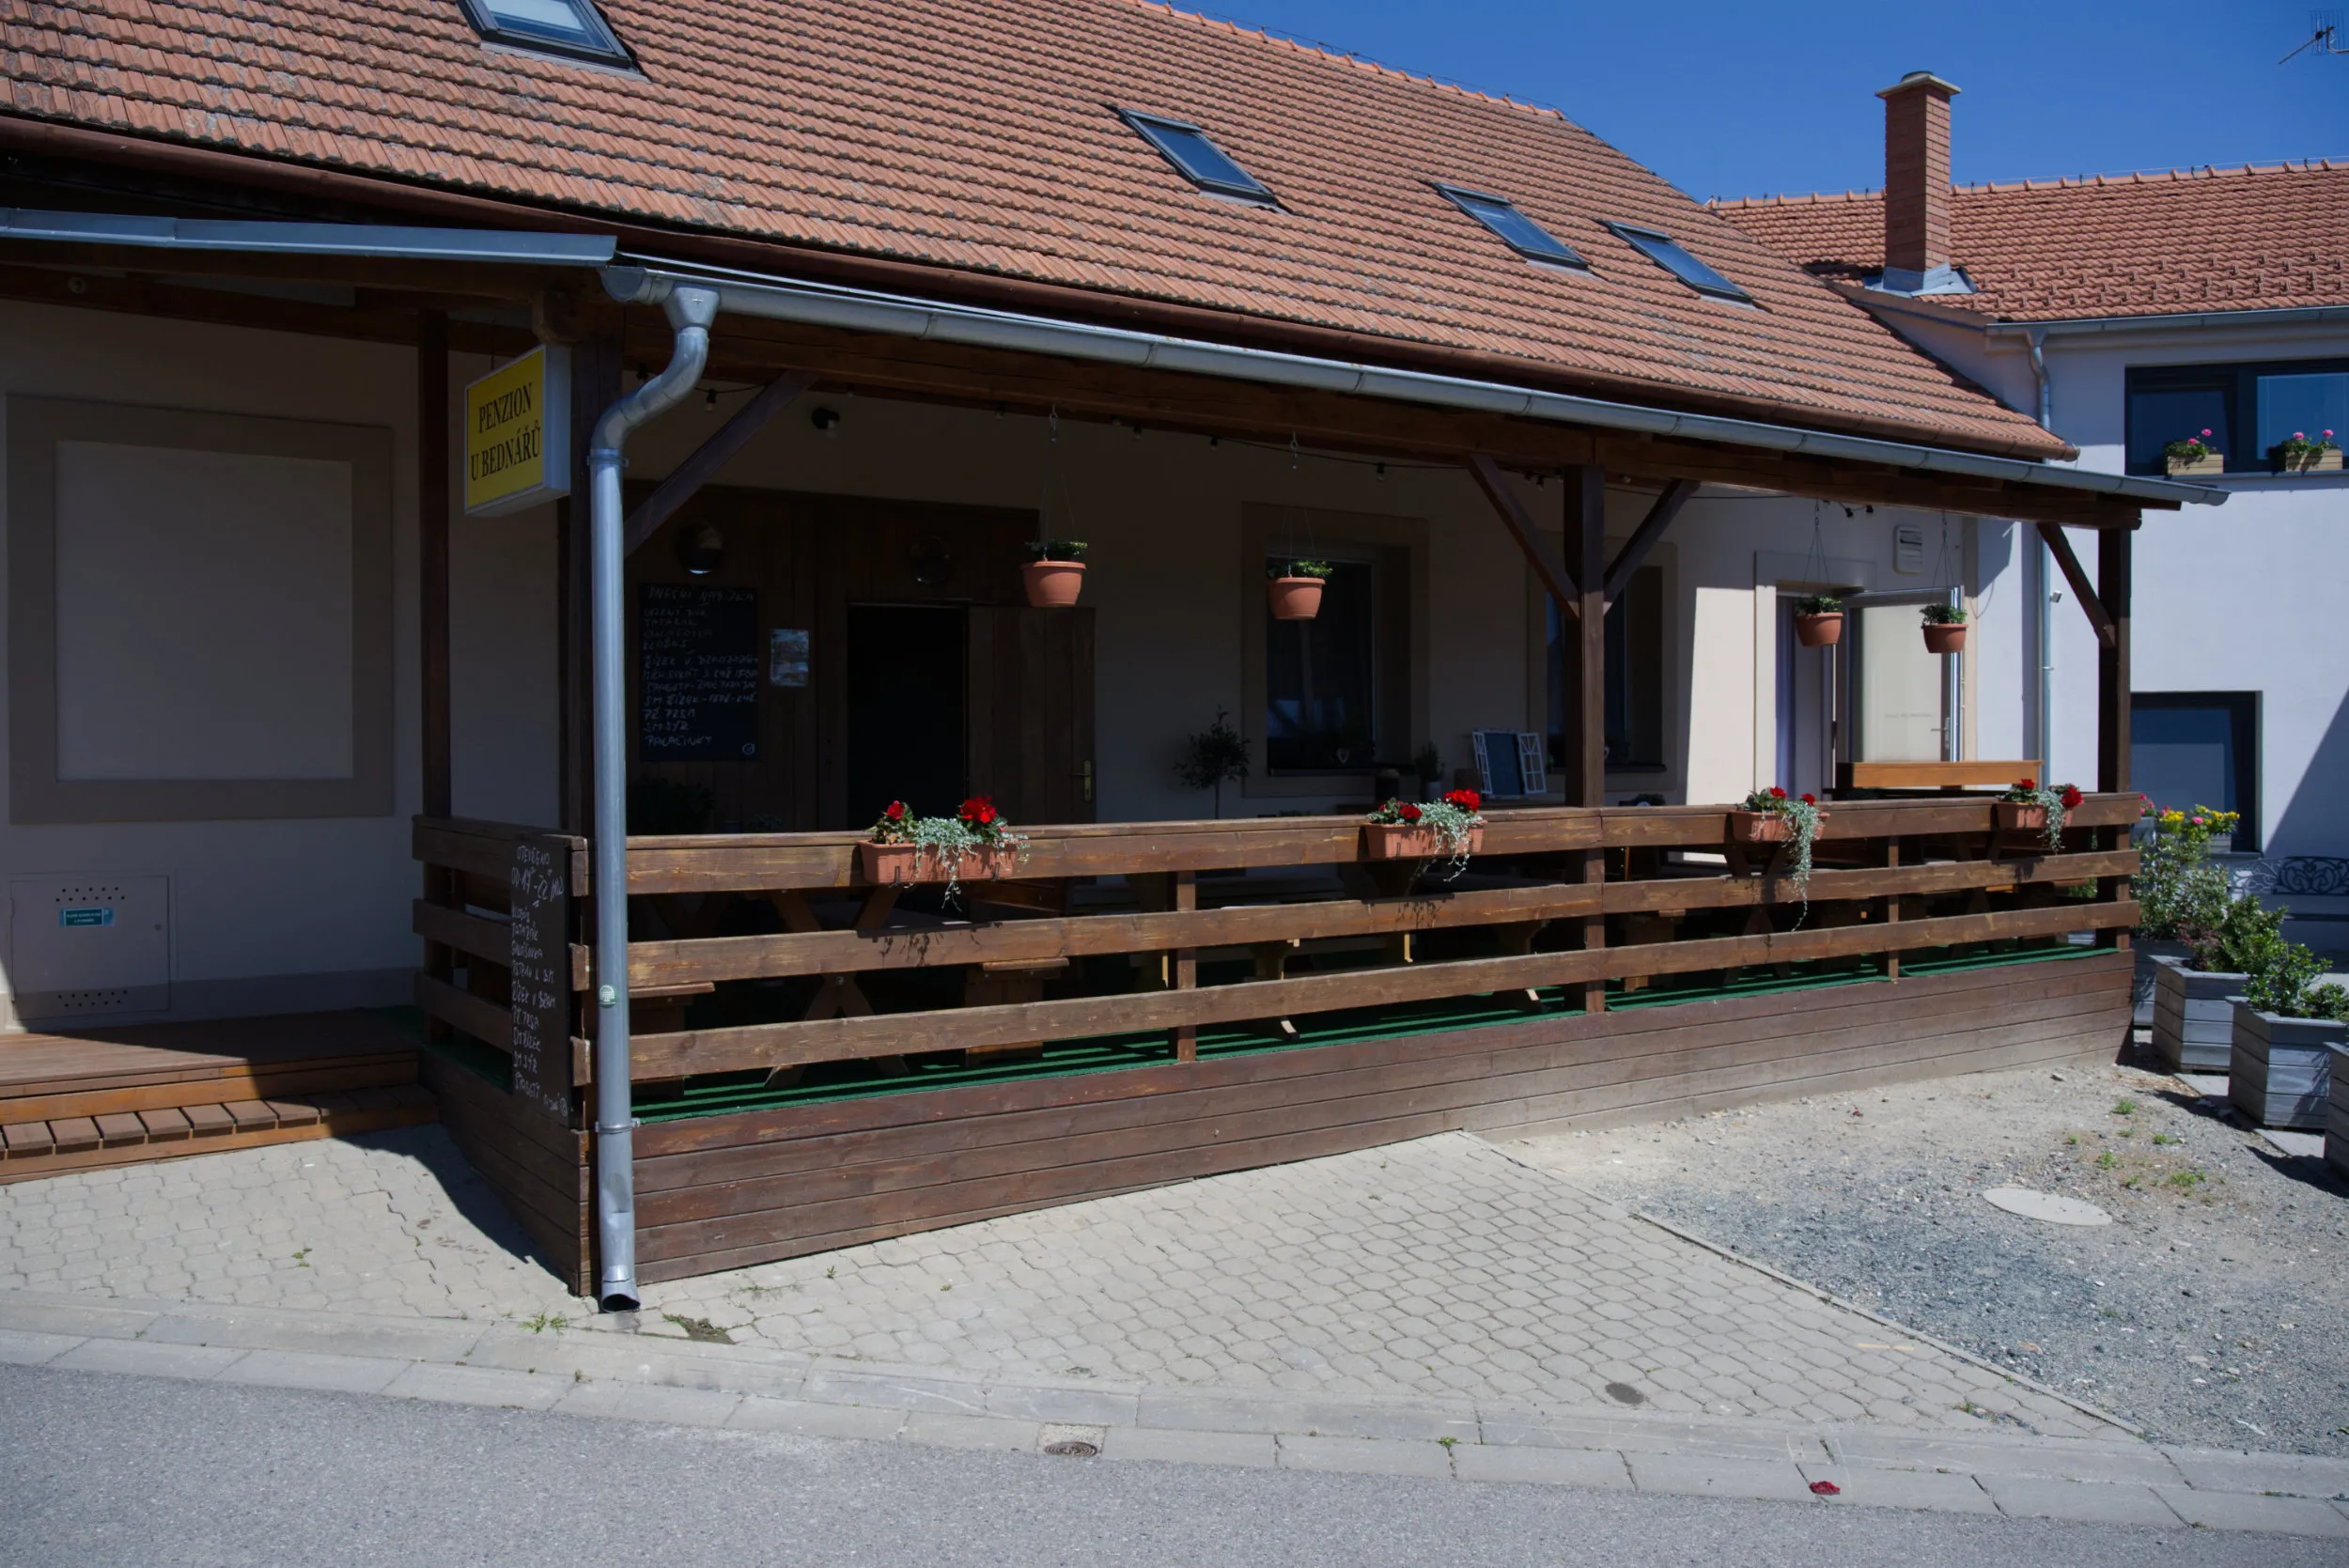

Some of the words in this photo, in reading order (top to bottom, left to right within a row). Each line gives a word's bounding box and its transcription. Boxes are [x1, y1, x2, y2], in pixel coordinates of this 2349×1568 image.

[478, 382, 532, 434] PENZION
[471, 454, 479, 482] U
[481, 420, 541, 478] BEDNÁŘŮ
